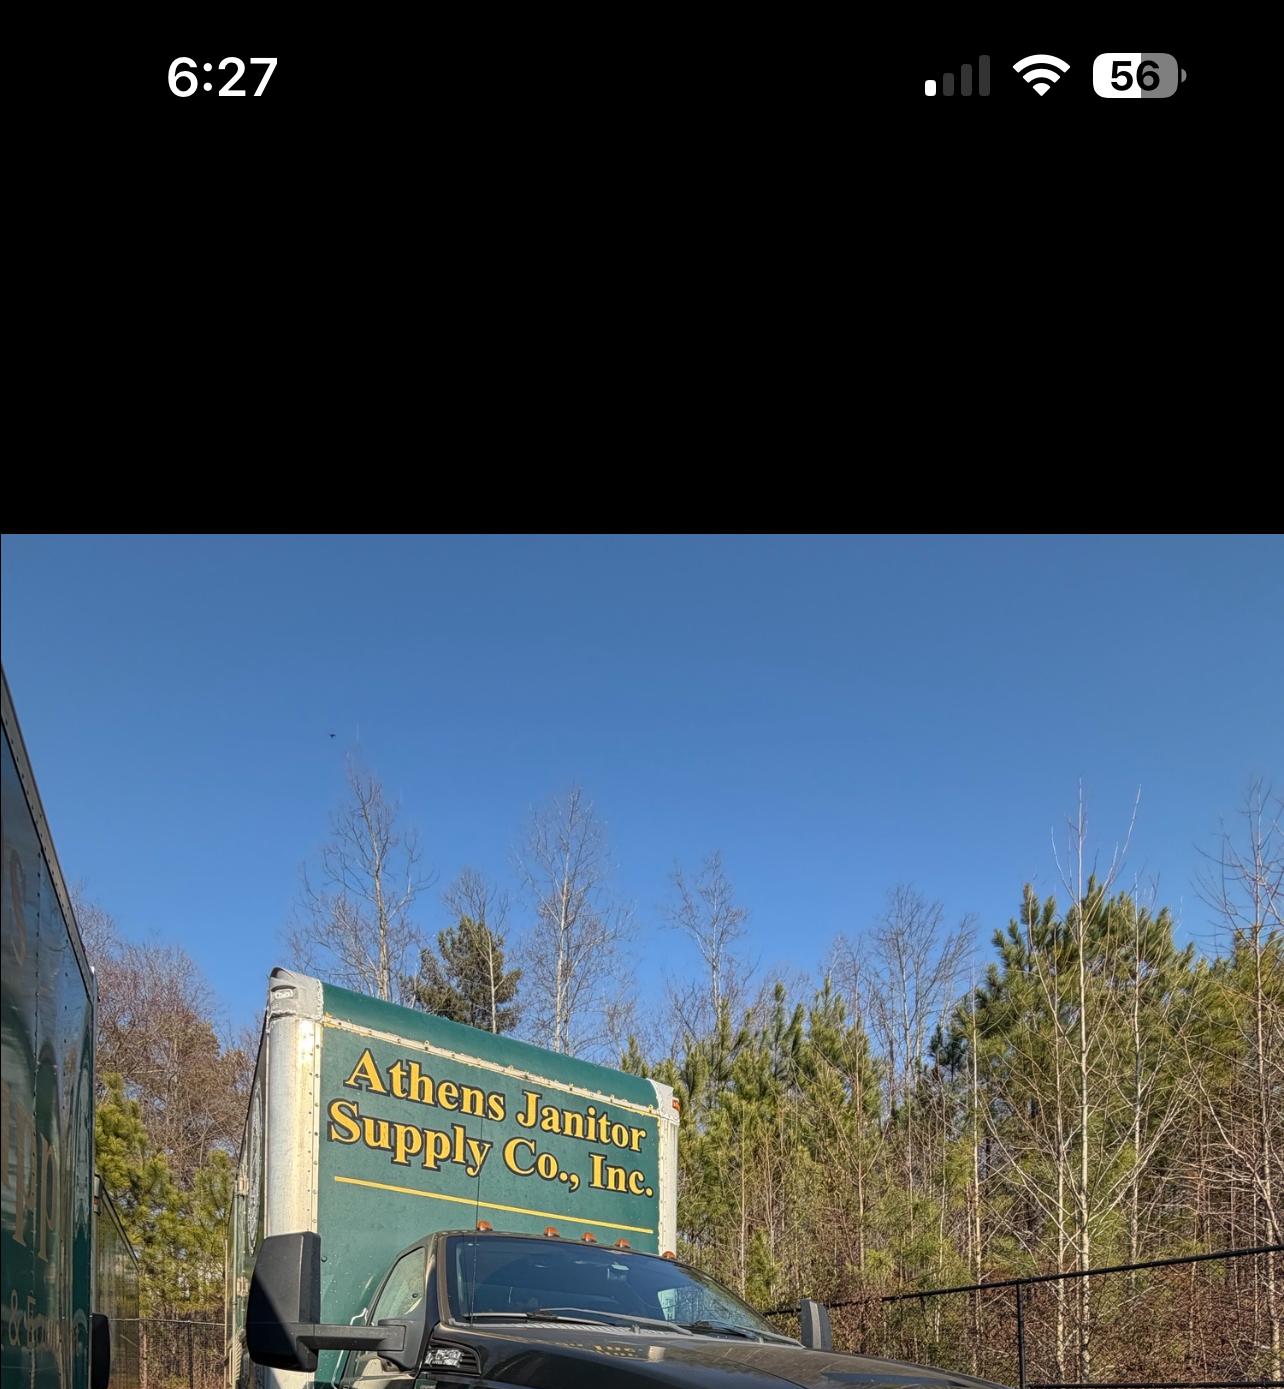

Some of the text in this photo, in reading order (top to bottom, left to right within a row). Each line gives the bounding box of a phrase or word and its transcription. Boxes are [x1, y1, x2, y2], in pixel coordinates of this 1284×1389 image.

[327, 1099, 655, 1198] Supply Co., Inc.
[344, 1048, 648, 1153] Athens Janitor
